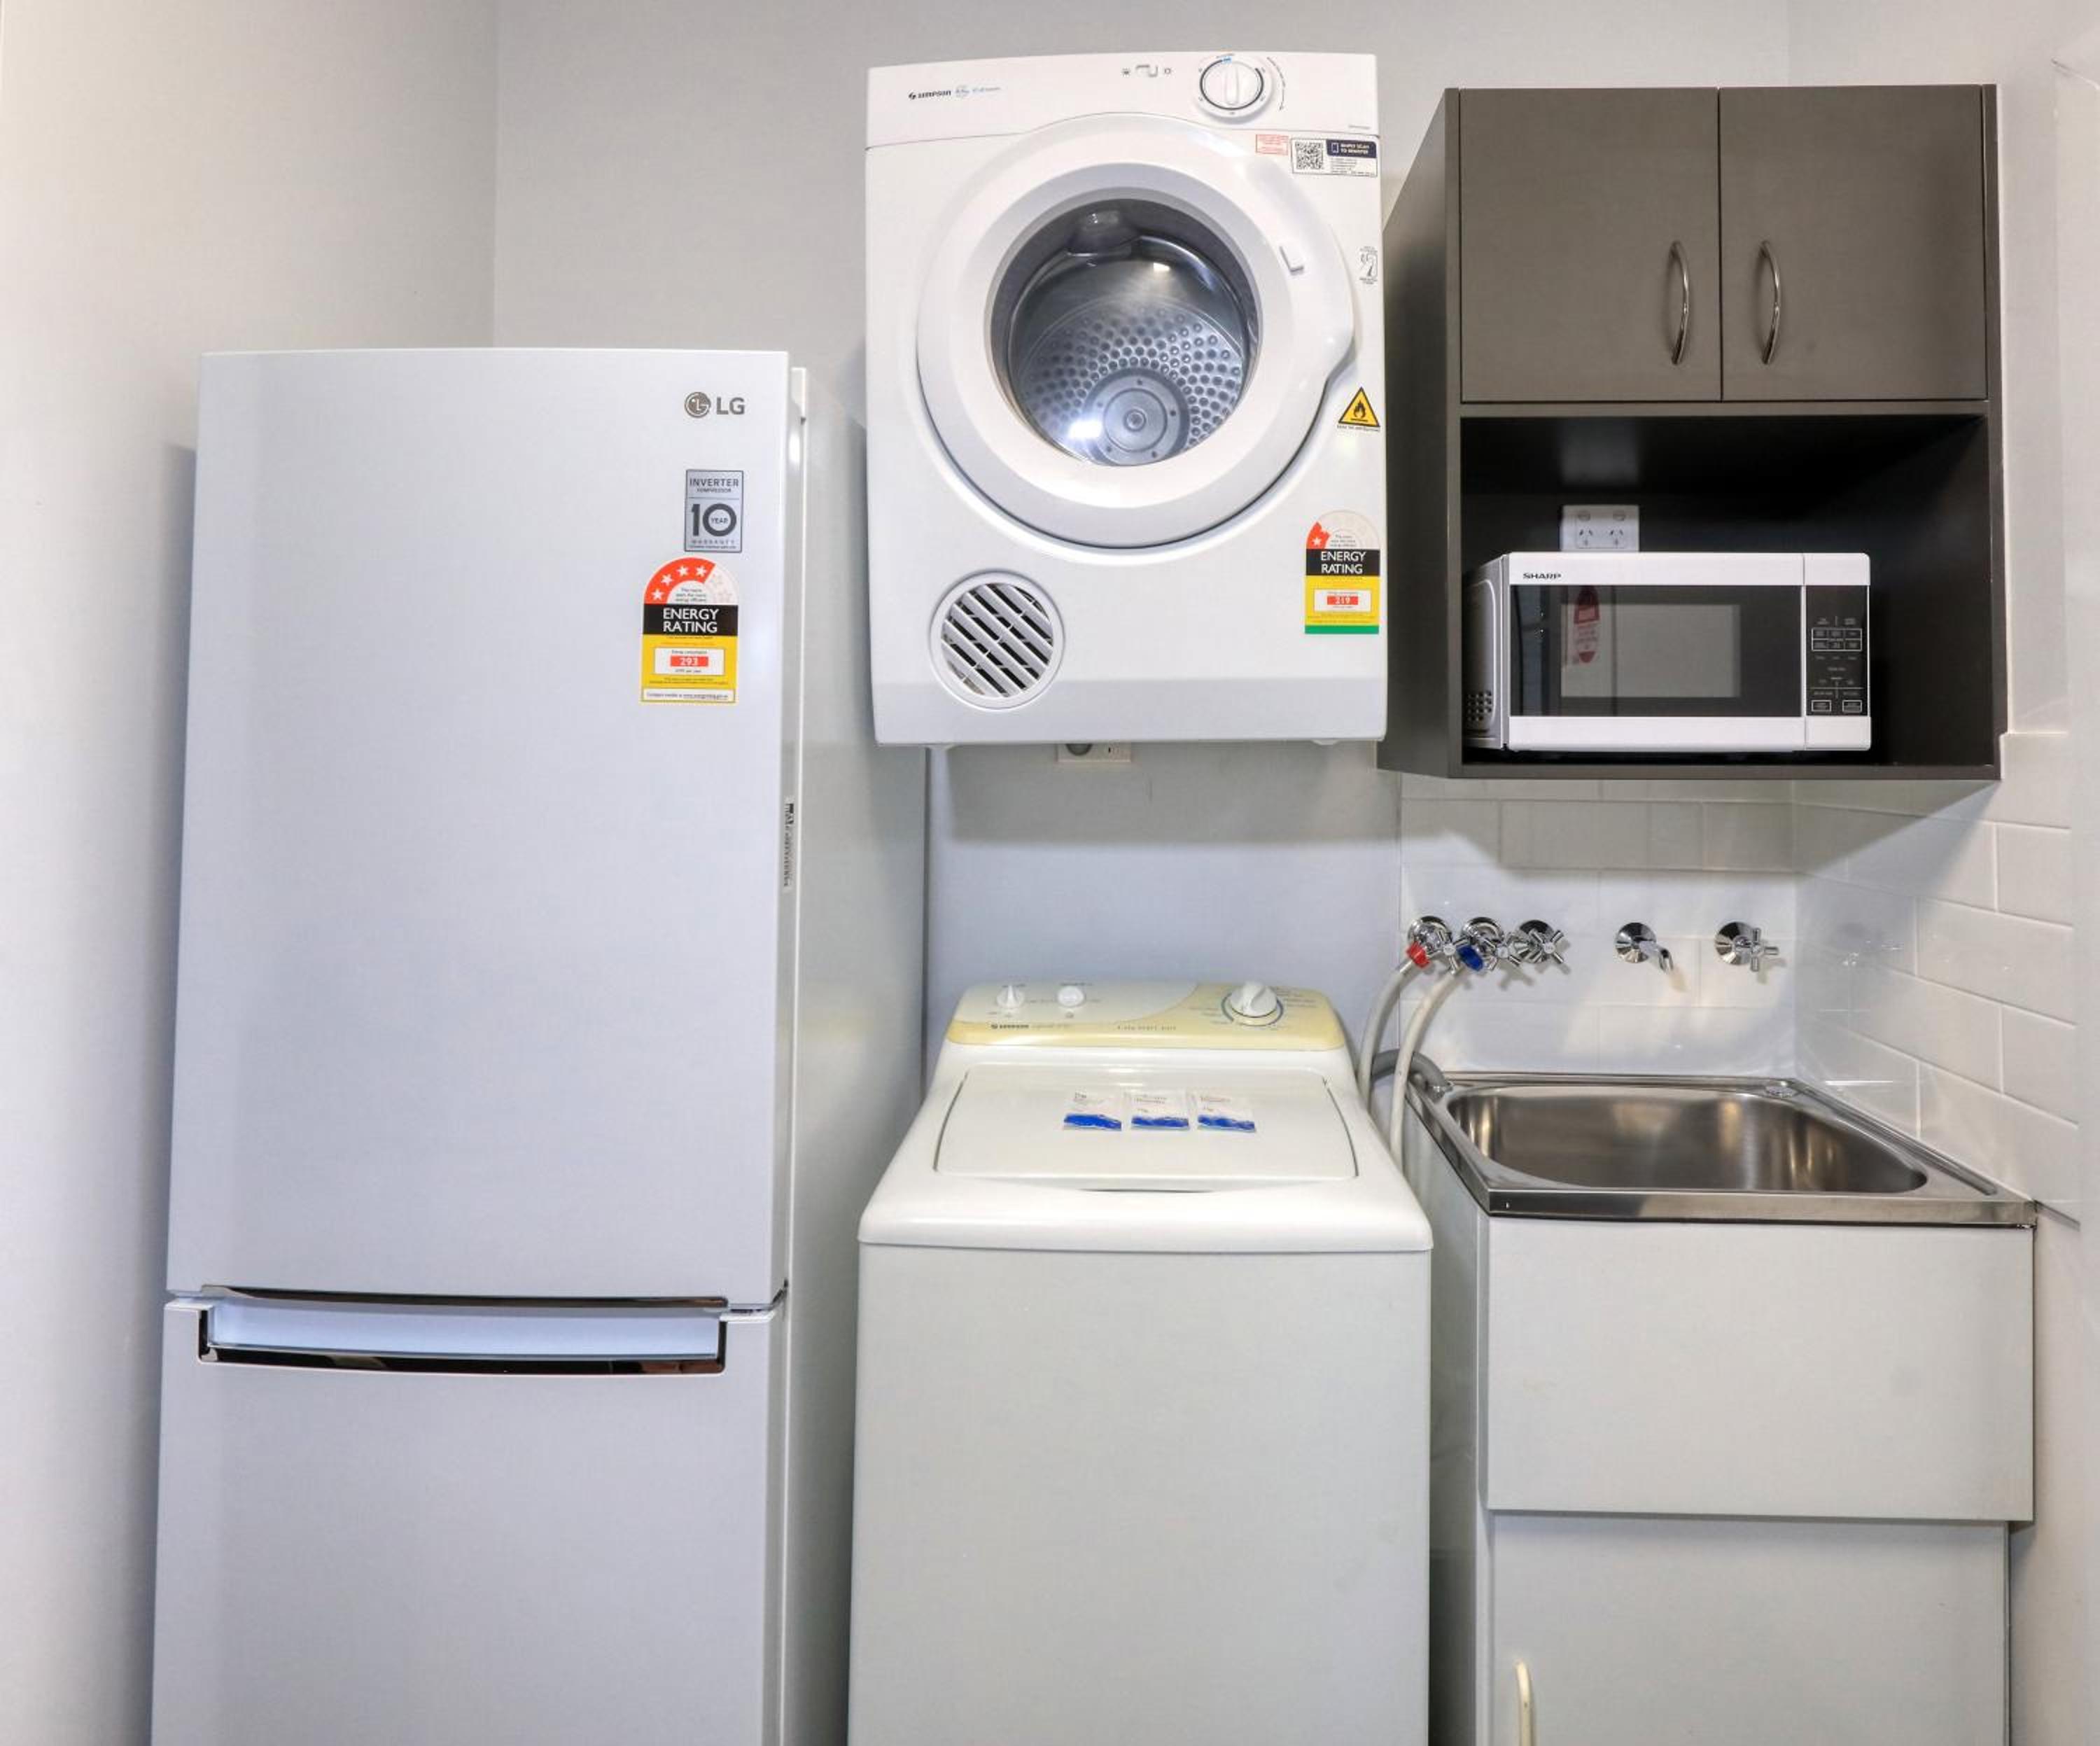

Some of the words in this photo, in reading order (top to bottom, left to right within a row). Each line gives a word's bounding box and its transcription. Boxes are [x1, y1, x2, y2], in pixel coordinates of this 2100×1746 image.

[716, 397, 745, 415] LG
[690, 478, 738, 487] INVERTER
[692, 503, 737, 537] 10
[1321, 551, 1366, 561] ENERGY
[1321, 564, 1363, 574] RATING
[663, 608, 720, 620] ENERGY
[663, 622, 718, 633] RATING
[680, 657, 699, 666] 293
